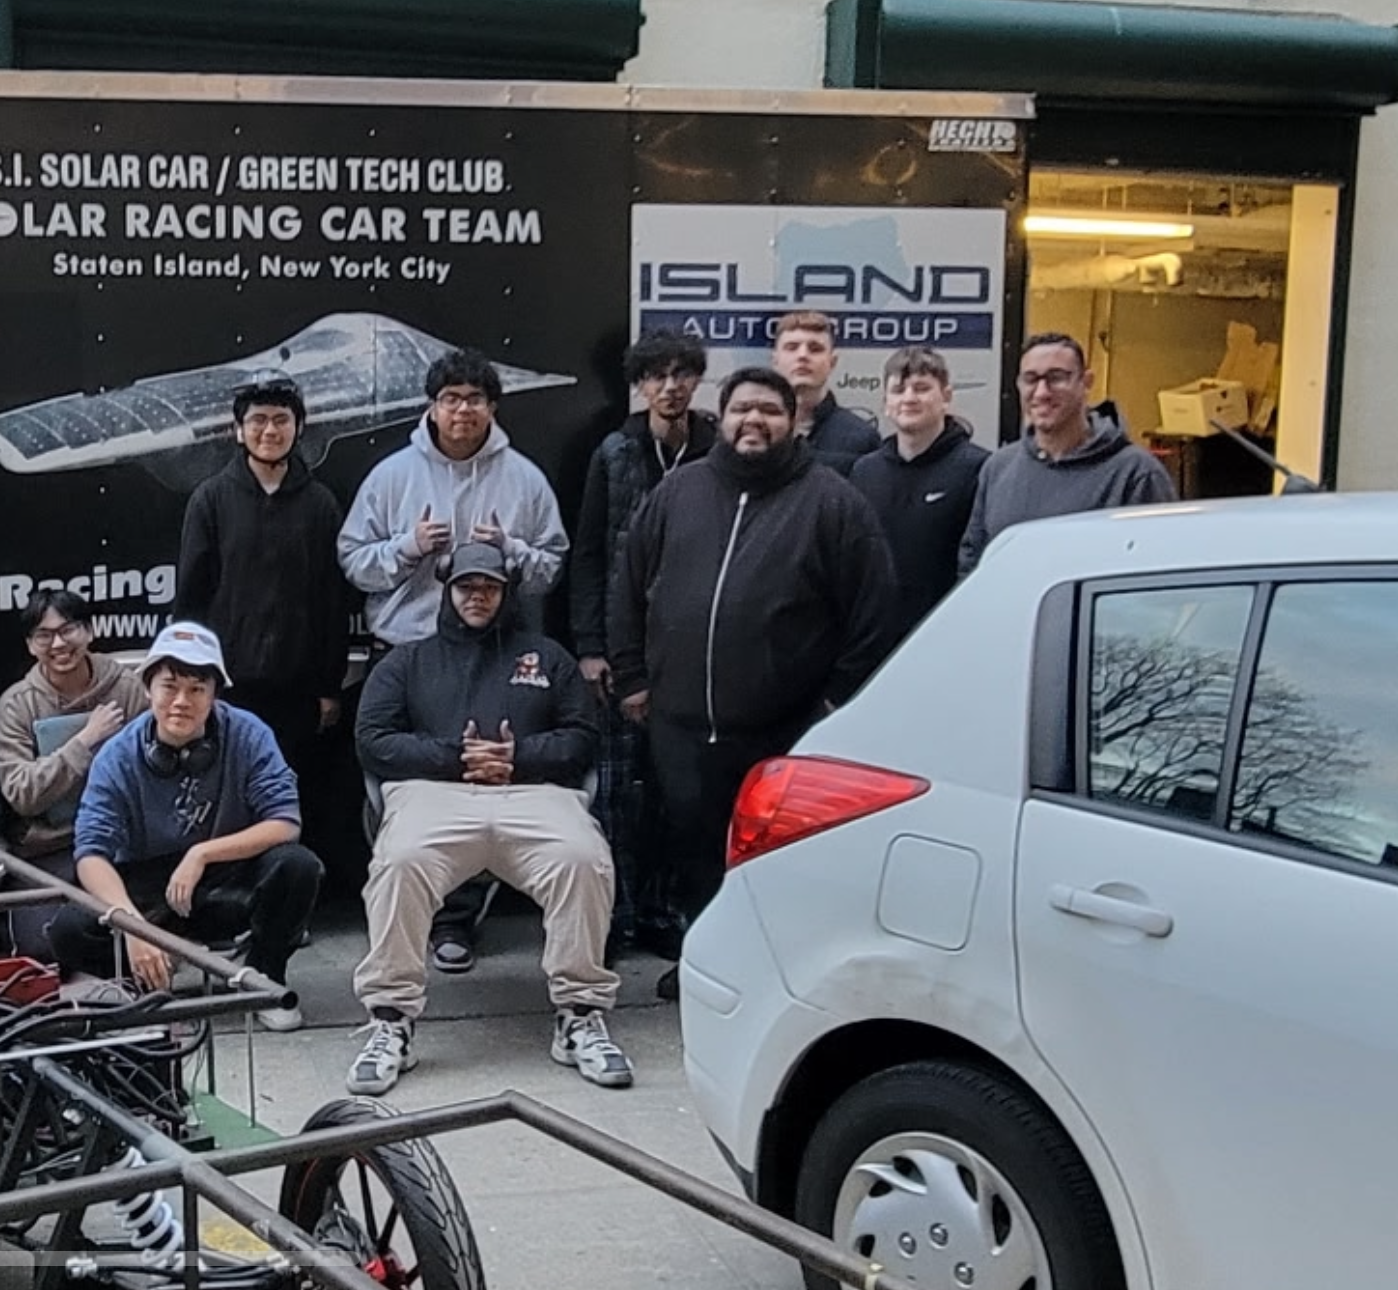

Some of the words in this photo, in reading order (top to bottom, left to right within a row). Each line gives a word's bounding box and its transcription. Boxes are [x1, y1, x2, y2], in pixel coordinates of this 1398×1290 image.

[40, 153, 141, 188] SOLAR
[148, 154, 209, 189] CAR
[215, 155, 231, 197] /
[239, 156, 339, 191] GREEN
[345, 157, 420, 193] TECH
[427, 158, 503, 193] CLUB
[125, 203, 303, 240] RACING
[320, 206, 407, 242] CAR
[422, 208, 542, 244] TEAM
[53, 253, 143, 276] Staten
[154, 253, 249, 280] Island,
[260, 255, 321, 278] New
[329, 256, 391, 279] York
[401, 257, 451, 284] City
[640, 263, 990, 304] ISLAND
[830, 316, 958, 341] ROUP
[837, 373, 881, 390] Jeep
